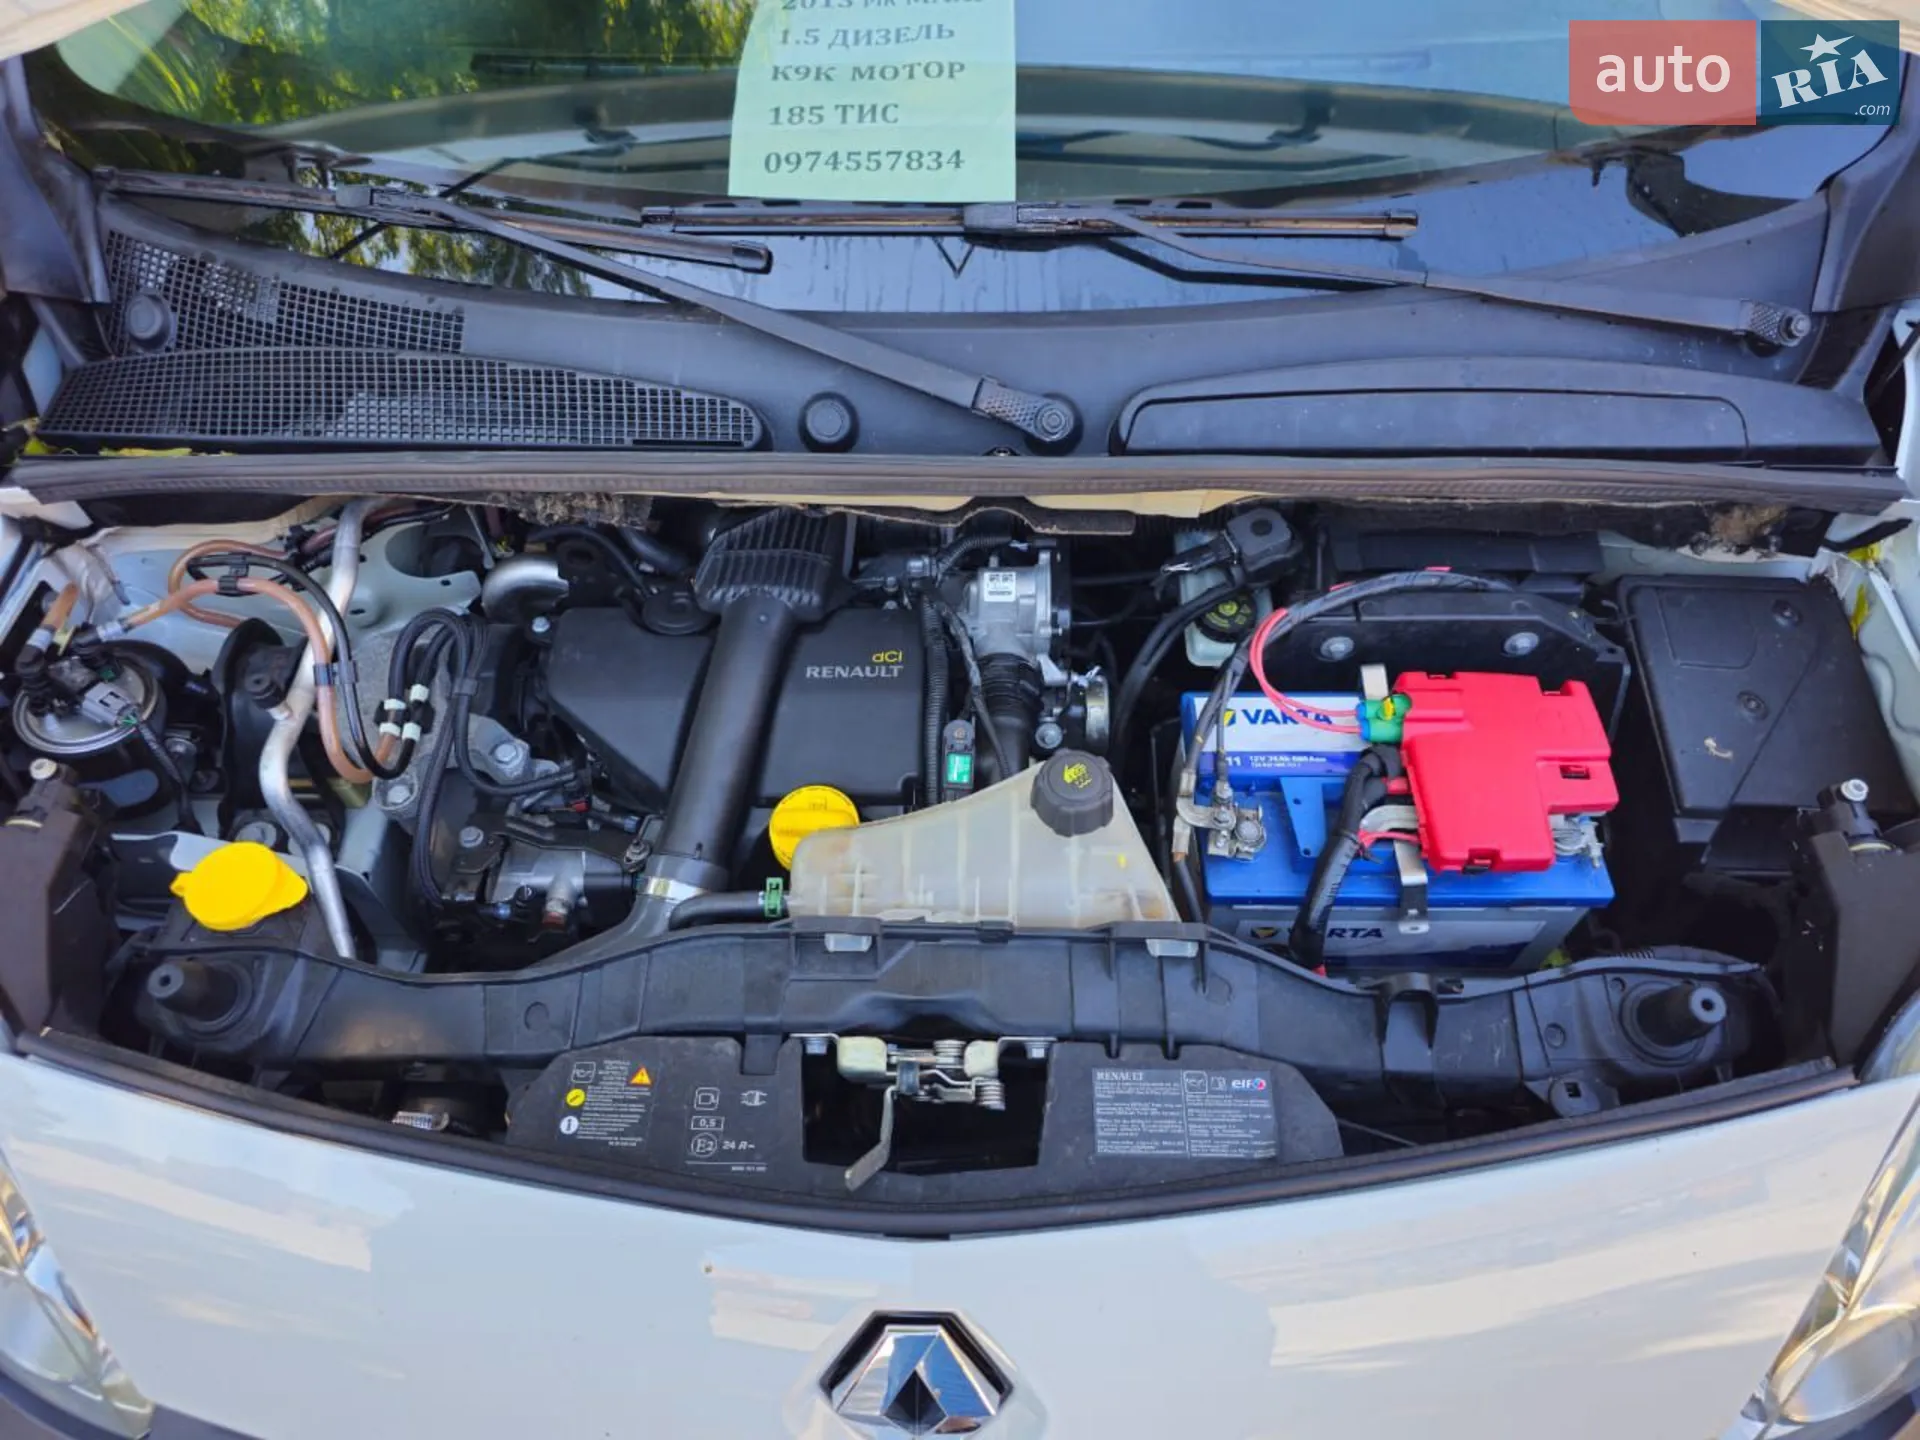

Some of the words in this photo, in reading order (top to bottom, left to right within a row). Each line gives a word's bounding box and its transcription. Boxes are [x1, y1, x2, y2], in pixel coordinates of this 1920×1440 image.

[781, 28, 820, 45] 1.5
[828, 24, 955, 49] ДИЗЕЛЬ
[851, 61, 966, 82] МОТОР
[769, 105, 825, 126] 185
[834, 103, 899, 125] ТИС
[764, 149, 966, 174] 0974557834
[805, 665, 904, 678] RENAULT
